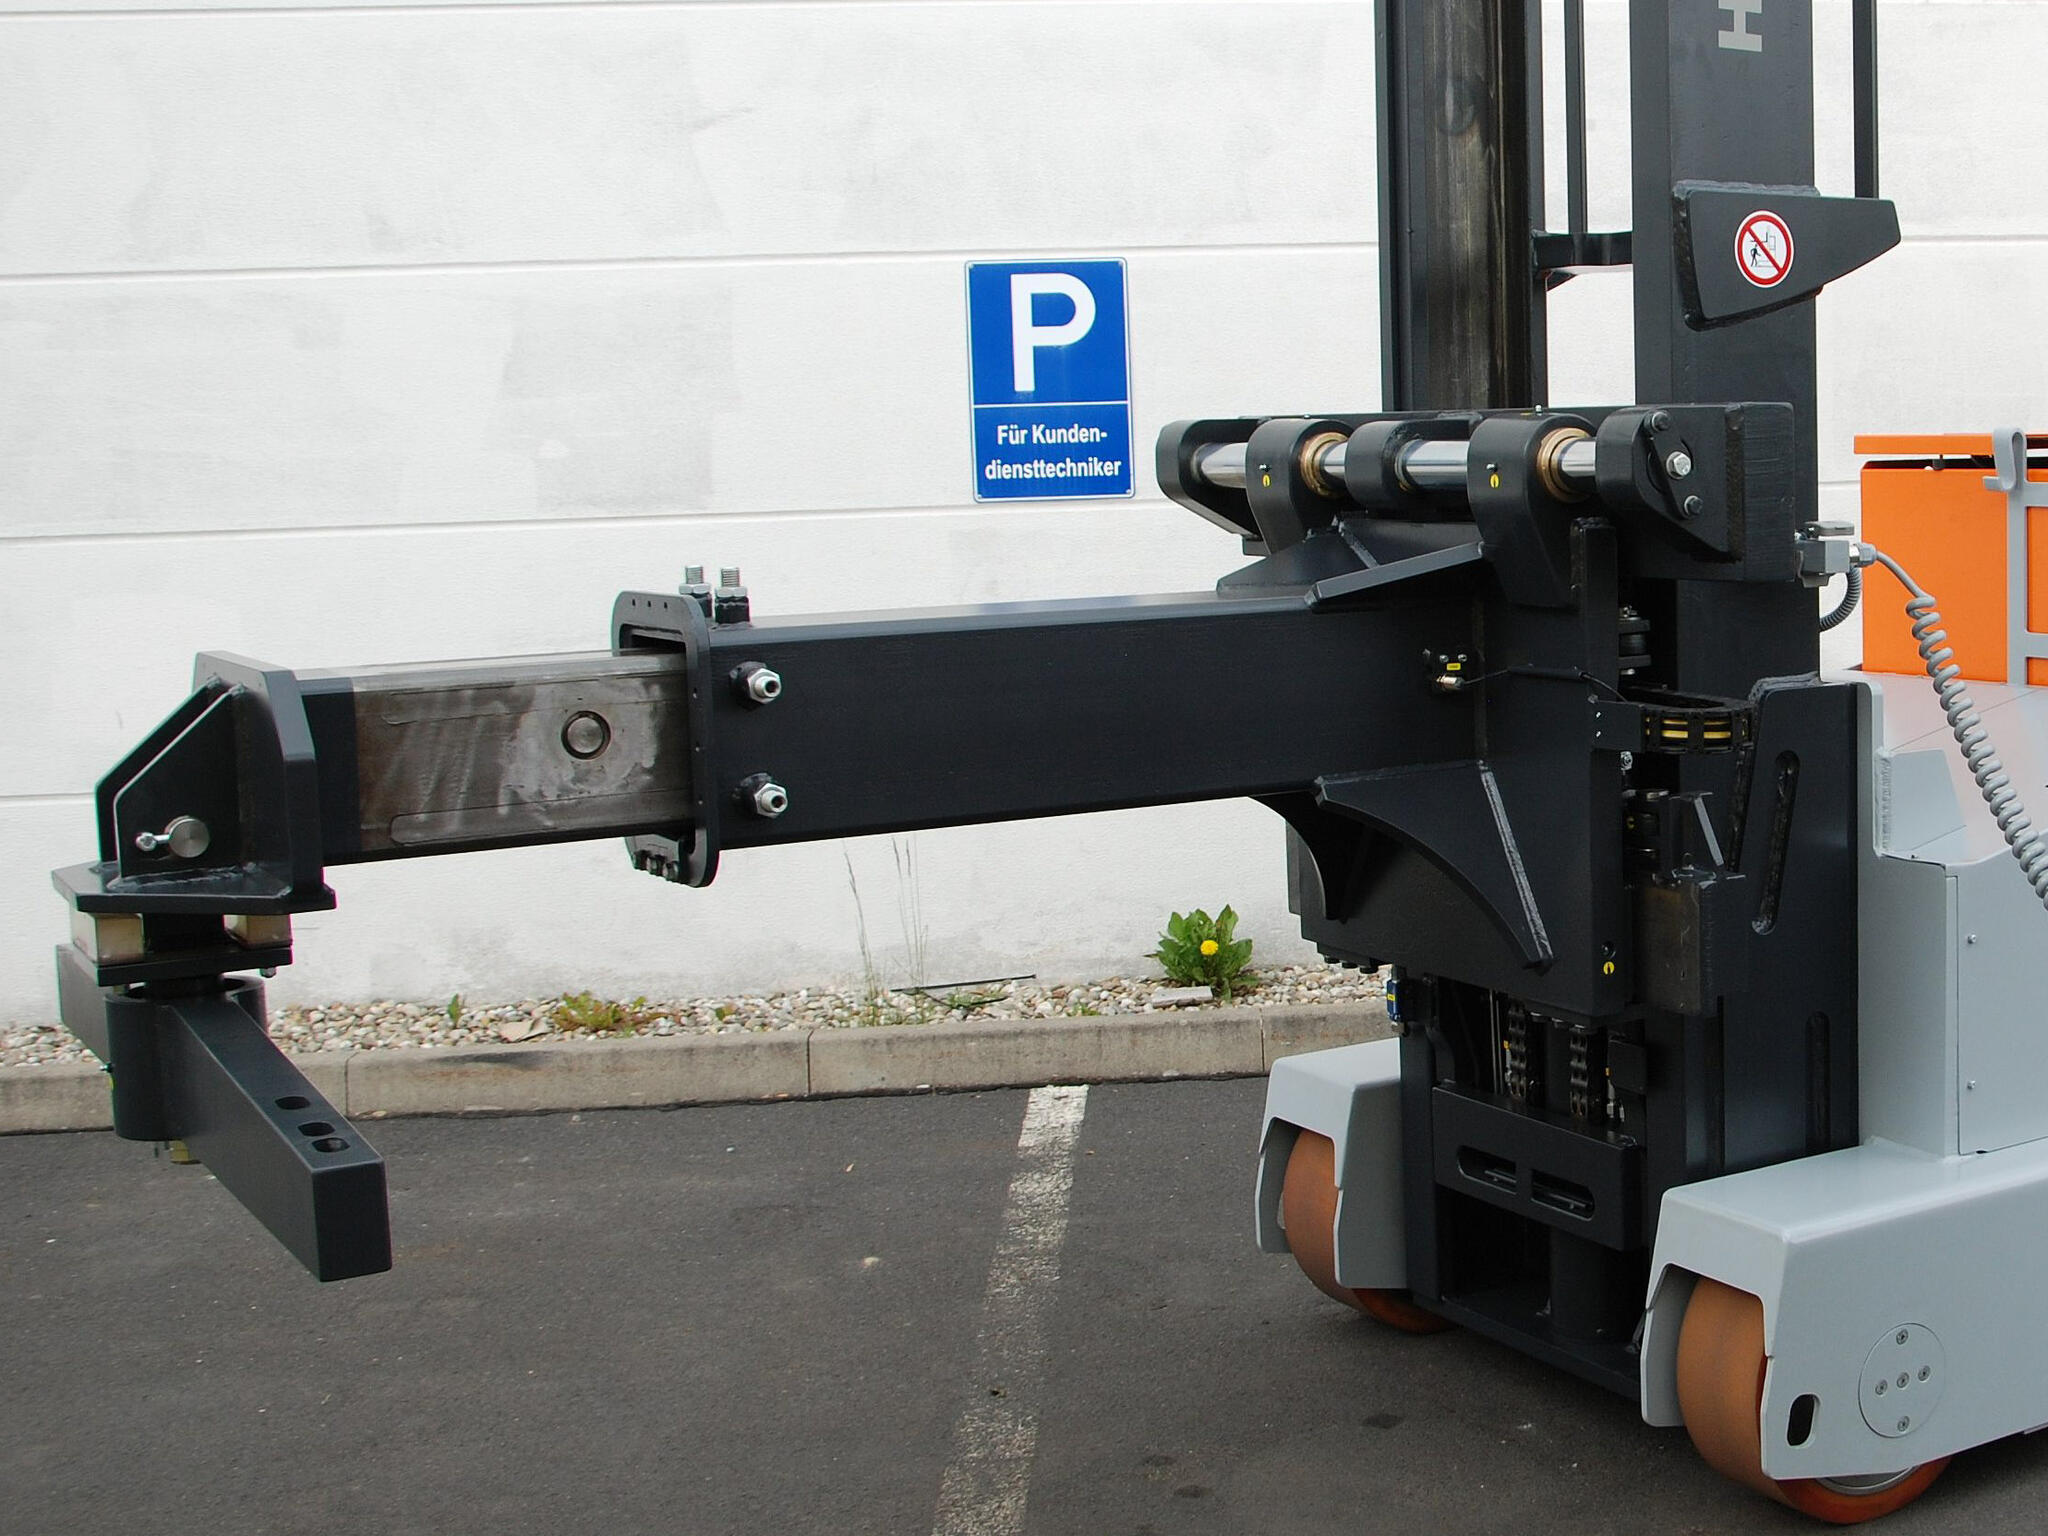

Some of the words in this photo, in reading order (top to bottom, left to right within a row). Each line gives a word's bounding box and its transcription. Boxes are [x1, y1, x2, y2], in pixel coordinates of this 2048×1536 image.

[1010, 272, 1096, 392] P
[997, 424, 1028, 445] Für
[1031, 423, 1108, 444] Kunden-
[984, 457, 1122, 480] diensttechniker
